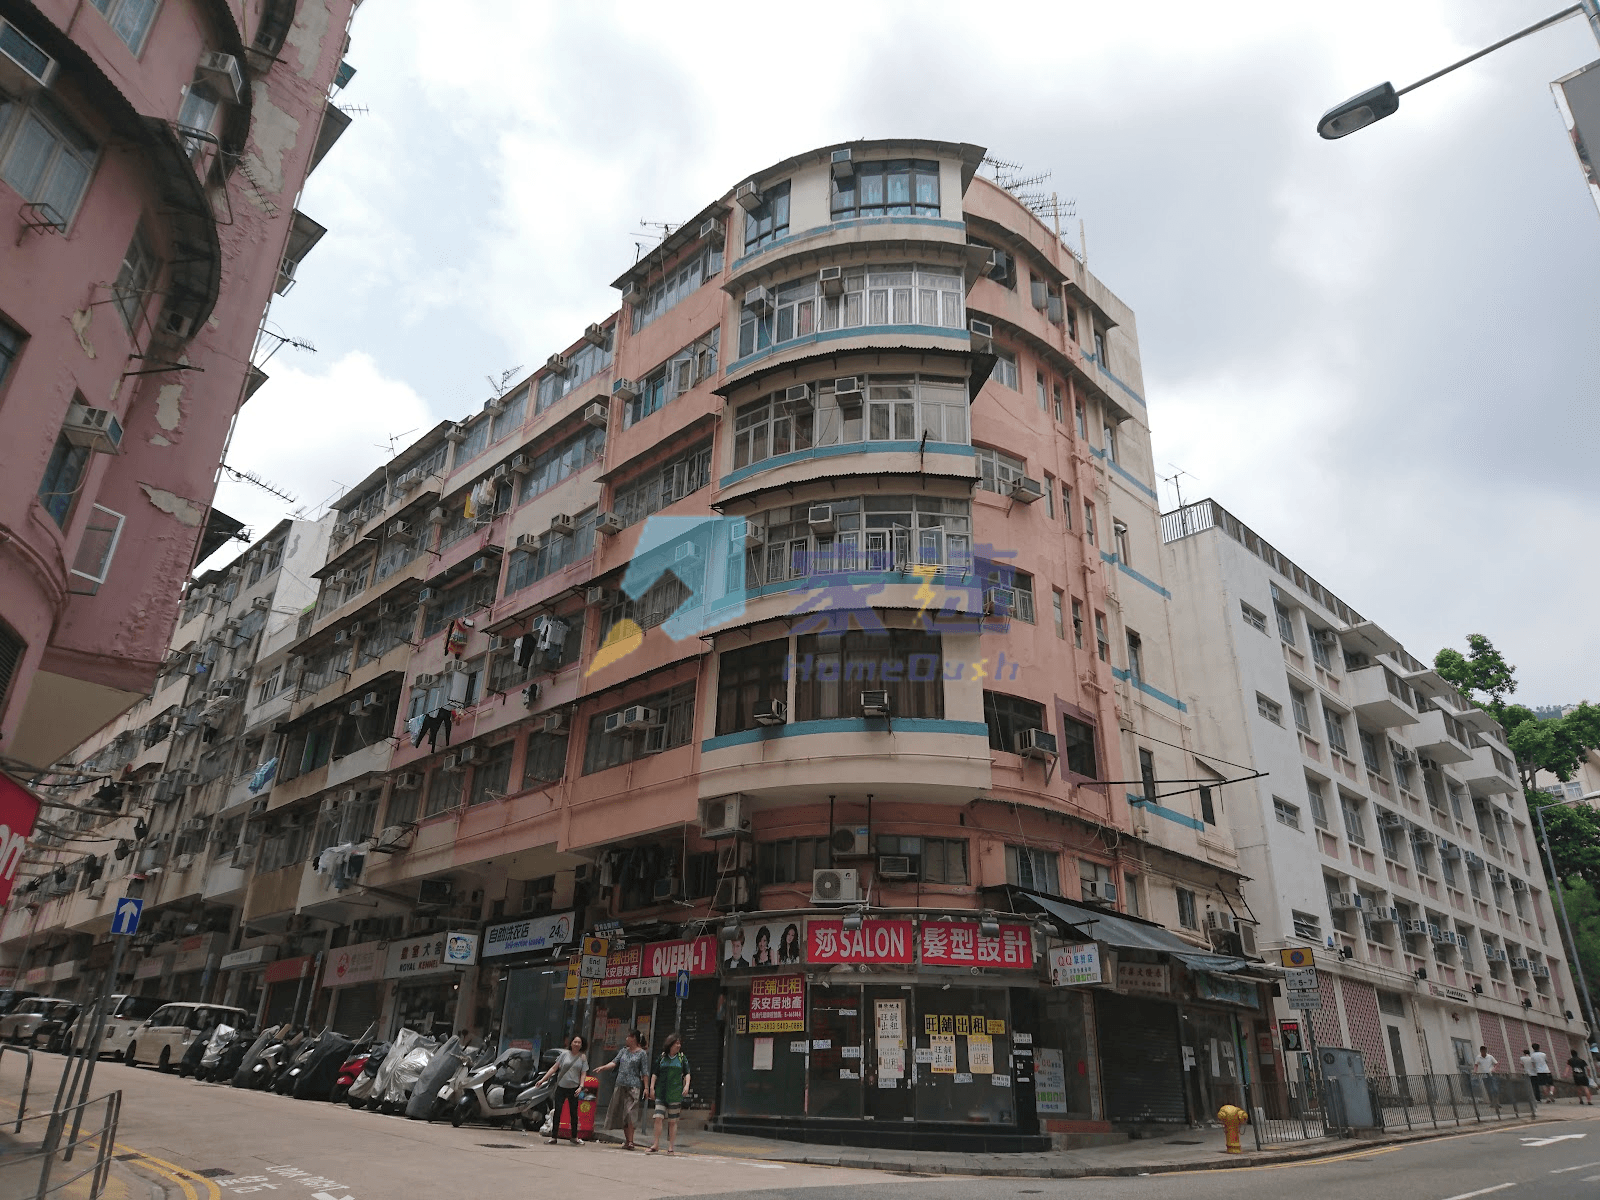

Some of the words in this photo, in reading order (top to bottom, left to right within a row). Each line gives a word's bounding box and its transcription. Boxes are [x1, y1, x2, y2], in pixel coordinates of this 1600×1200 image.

[488, 923, 531, 944] 自助洗衣店
[549, 925, 561, 939] 24
[400, 941, 442, 960] 皇室犬舍
[814, 927, 904, 958] 莎SALON
[923, 927, 1028, 964] 髮型設計
[399, 962, 416, 972] ROYAL
[418, 959, 438, 970] KENNEL
[589, 957, 601, 966] End
[653, 941, 707, 977] QUEEN-1
[586, 966, 601, 976] 終止
[752, 977, 802, 996] 旺舖出租
[1298, 979, 1313, 987] 5-7
[751, 996, 803, 1011] 永安居地產
[737, 1016, 746, 1032] 旺
[926, 1016, 985, 1033] 旺舖出租
[973, 1053, 990, 1065] 出租
